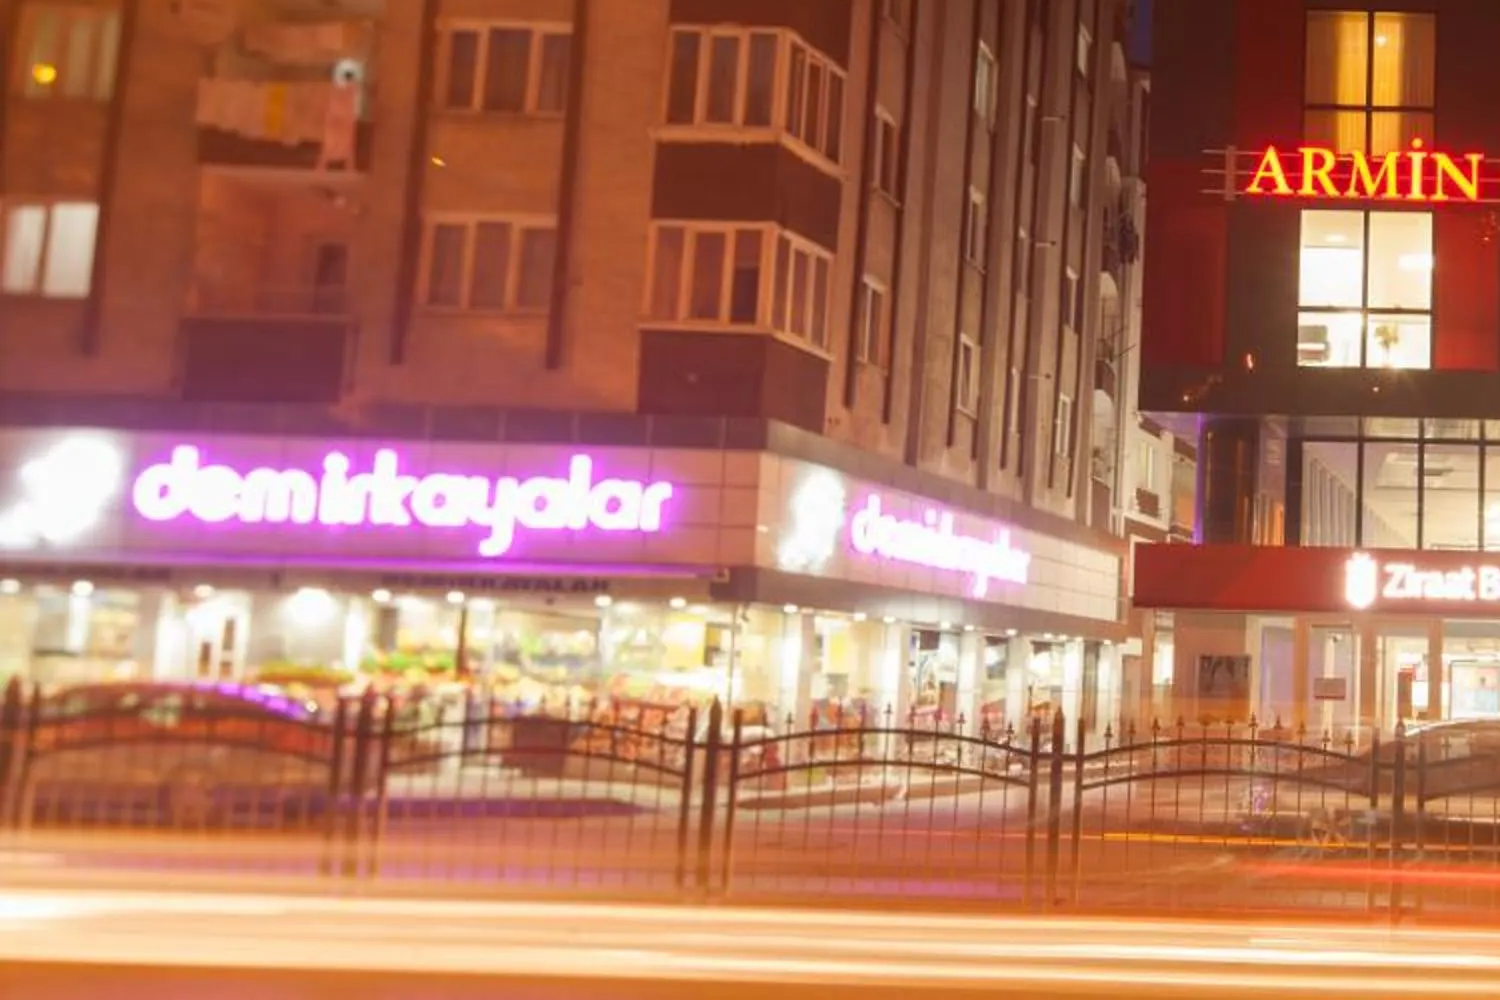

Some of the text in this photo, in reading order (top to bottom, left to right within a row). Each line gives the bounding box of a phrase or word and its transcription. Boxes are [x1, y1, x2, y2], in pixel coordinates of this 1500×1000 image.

[1245, 137, 1485, 202] ARMİN
[132, 444, 673, 556] demirkayalar
[1381, 562, 1476, 601] Ziraat
